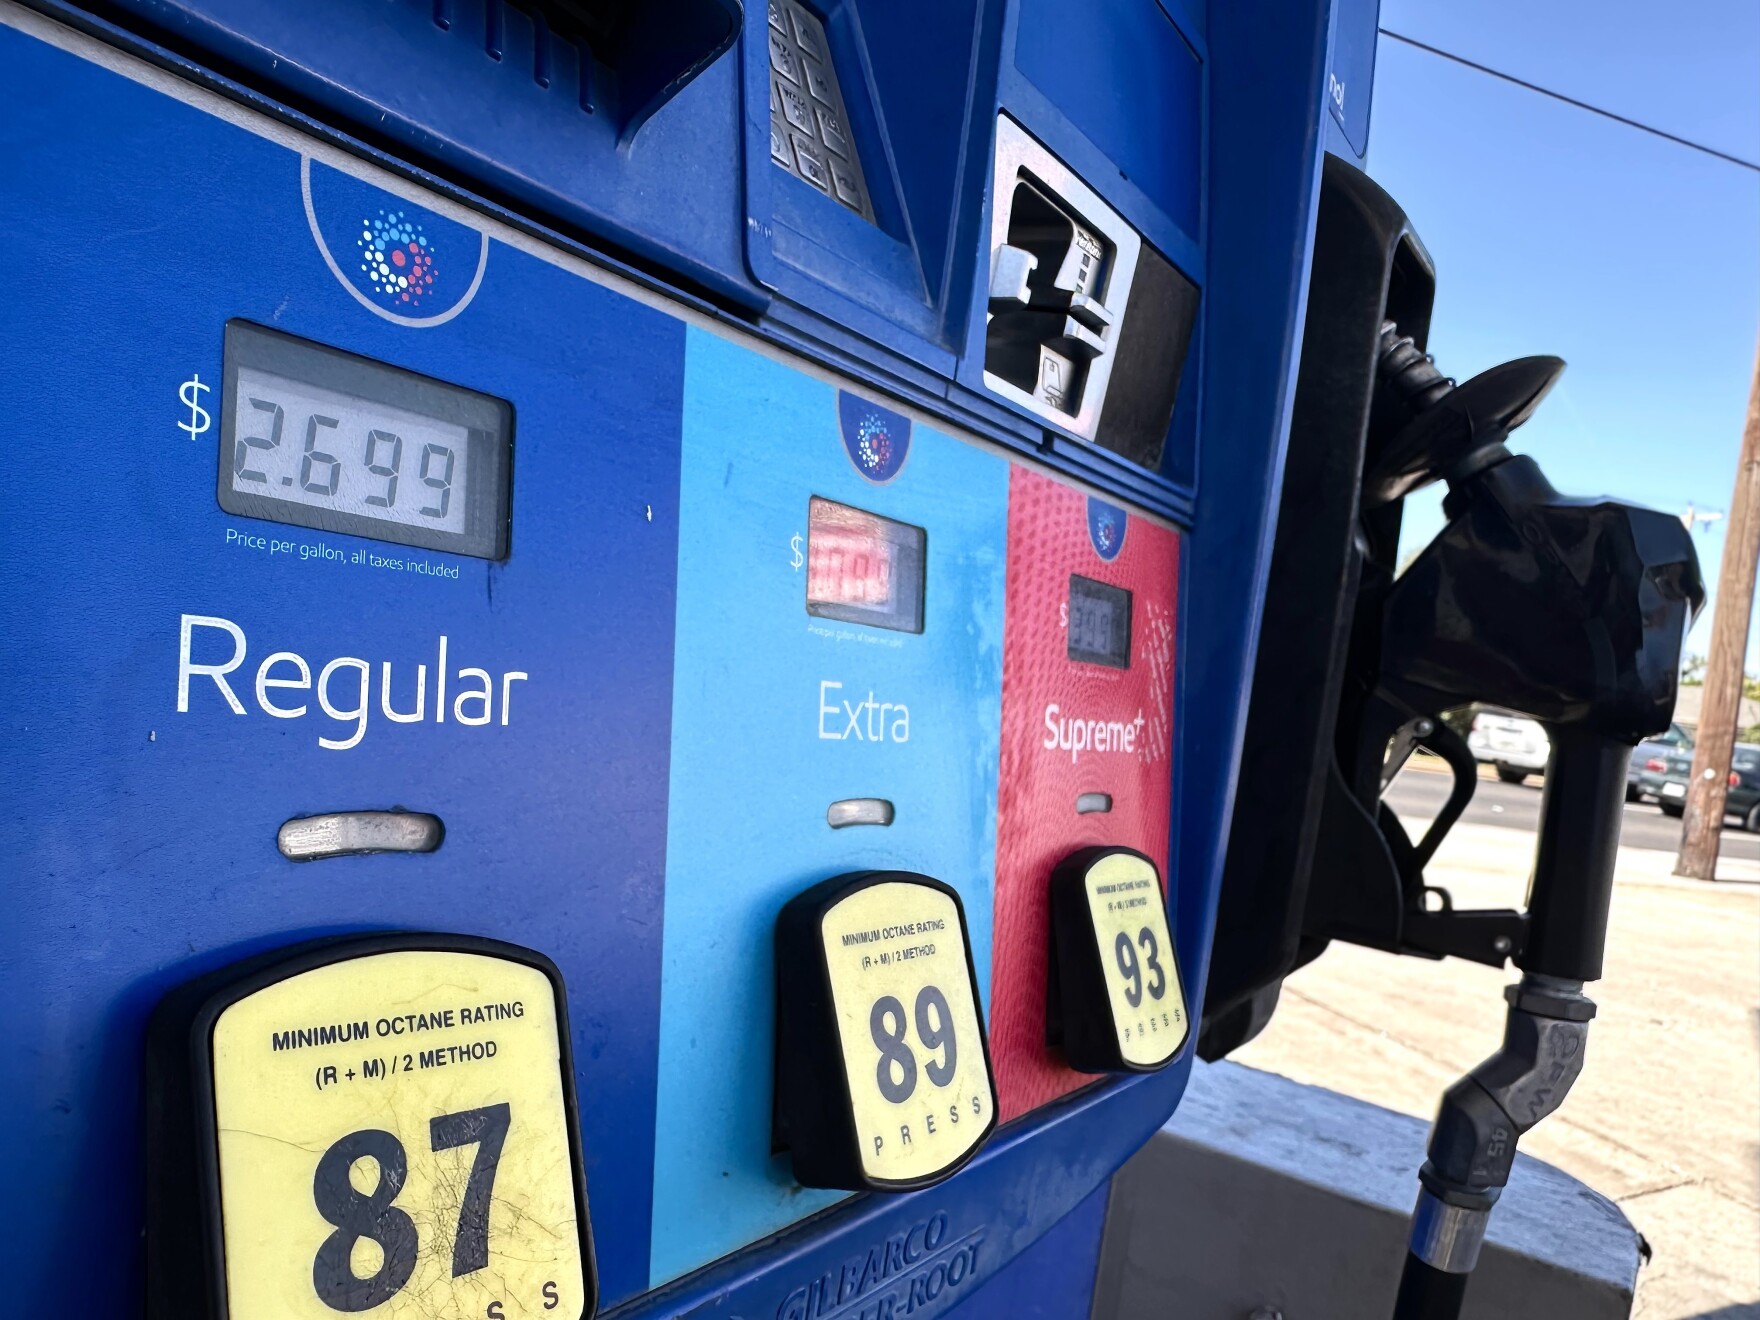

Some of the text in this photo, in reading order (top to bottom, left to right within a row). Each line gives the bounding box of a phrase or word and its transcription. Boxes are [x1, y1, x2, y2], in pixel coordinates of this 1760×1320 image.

[177, 374, 211, 441] $
[235, 397, 455, 519] 2.699
[226, 528, 460, 579] Price per gallon, all taxes included
[790, 532, 804, 571] $
[177, 614, 528, 750] Regular
[819, 680, 909, 743] Extra
[841, 918, 946, 946] MINIMUM OCTANE RATING
[895, 950, 902, 962] 2
[902, 943, 937, 960] METHOD
[1115, 926, 1166, 1008] 93
[272, 1001, 525, 1051] MINIMUM OCTANE RATING
[870, 985, 958, 1104] 89
[315, 1065, 338, 1091] (R
[344, 1068, 356, 1081] +
[362, 1058, 386, 1081] M)
[402, 1054, 414, 1072] 2
[419, 1040, 498, 1069] METHOD
[874, 1095, 982, 1157] PRESS
[313, 1102, 512, 1313] 87
